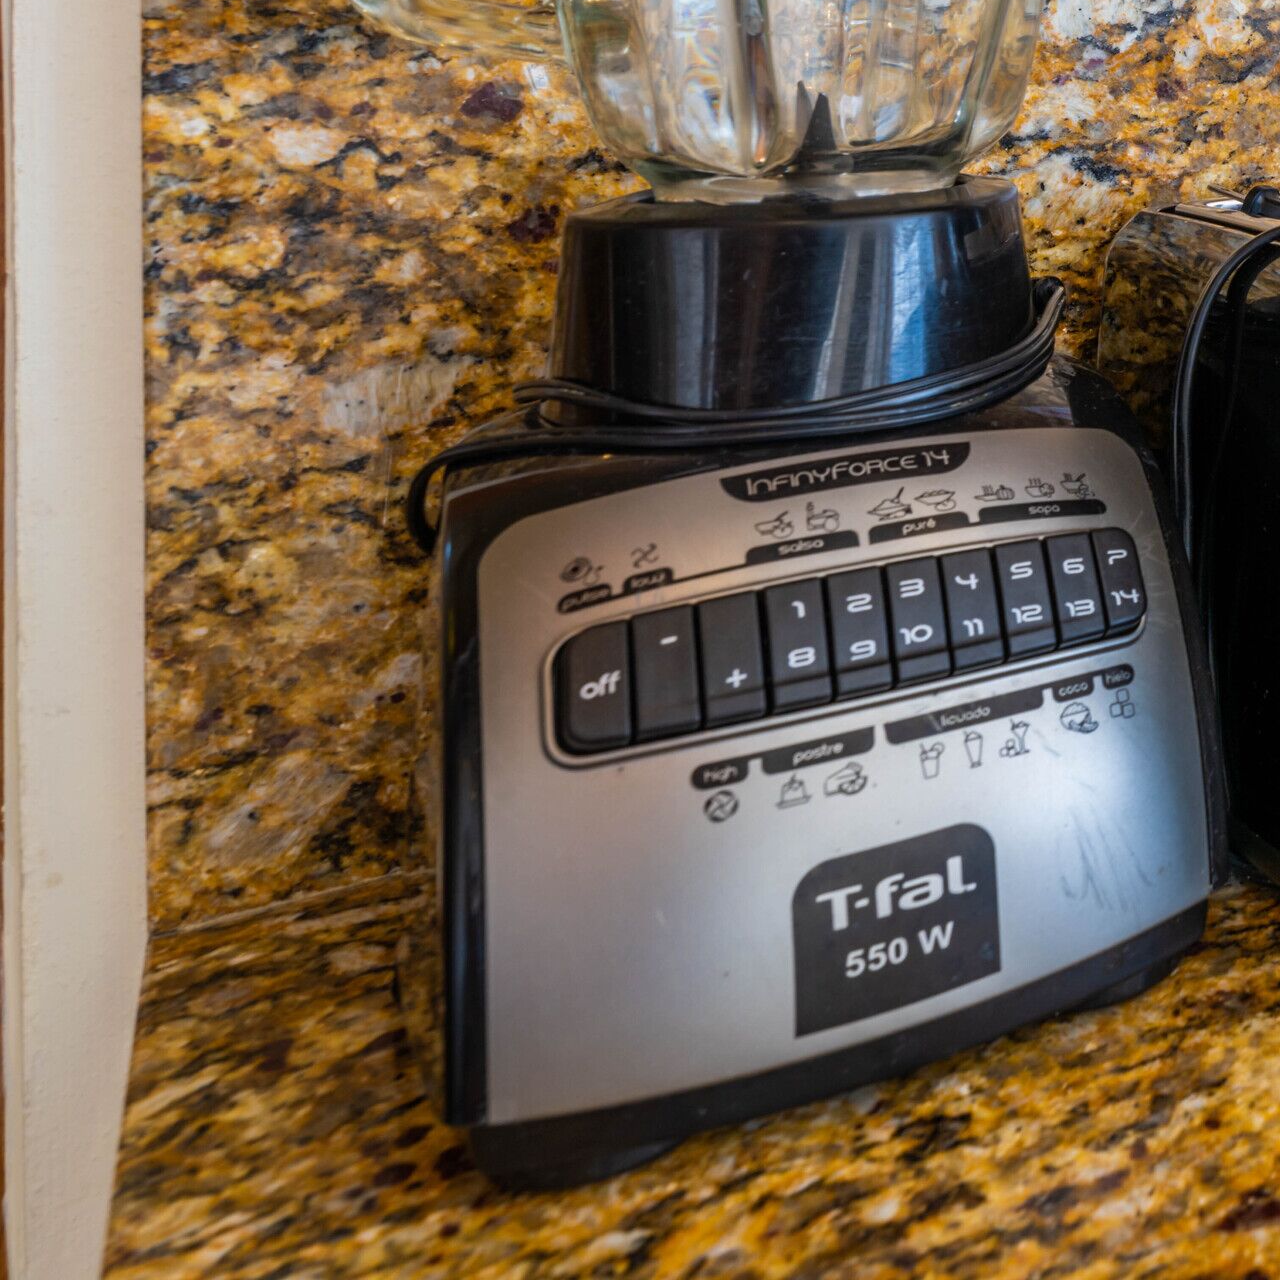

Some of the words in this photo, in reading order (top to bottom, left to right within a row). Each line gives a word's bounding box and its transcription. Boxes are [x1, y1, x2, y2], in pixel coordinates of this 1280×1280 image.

[922, 449, 950, 467] 14
[1028, 503, 1061, 516] sopa
[902, 518, 936, 536] puré
[777, 539, 824, 555] salsa
[791, 600, 806, 618] 1
[846, 593, 873, 613] 2
[900, 578, 925, 598] 3
[955, 573, 979, 590] 4
[1010, 561, 1033, 580] 5
[1063, 558, 1085, 575] 6
[788, 646, 816, 668] 8
[849, 640, 877, 661] 9
[900, 624, 933, 645] 10
[963, 618, 984, 637] 11
[1012, 604, 1043, 624] 12
[1065, 598, 1095, 618] 13
[1111, 588, 1140, 606] 14
[580, 670, 621, 700] off
[1105, 669, 1132, 685] hielo
[1058, 681, 1088, 697] coco
[941, 705, 991, 727] licuado
[792, 742, 844, 765] postre
[702, 764, 739, 784] high
[815, 855, 977, 931] T-fal
[845, 936, 909, 978] 550
[918, 920, 955, 955] W
